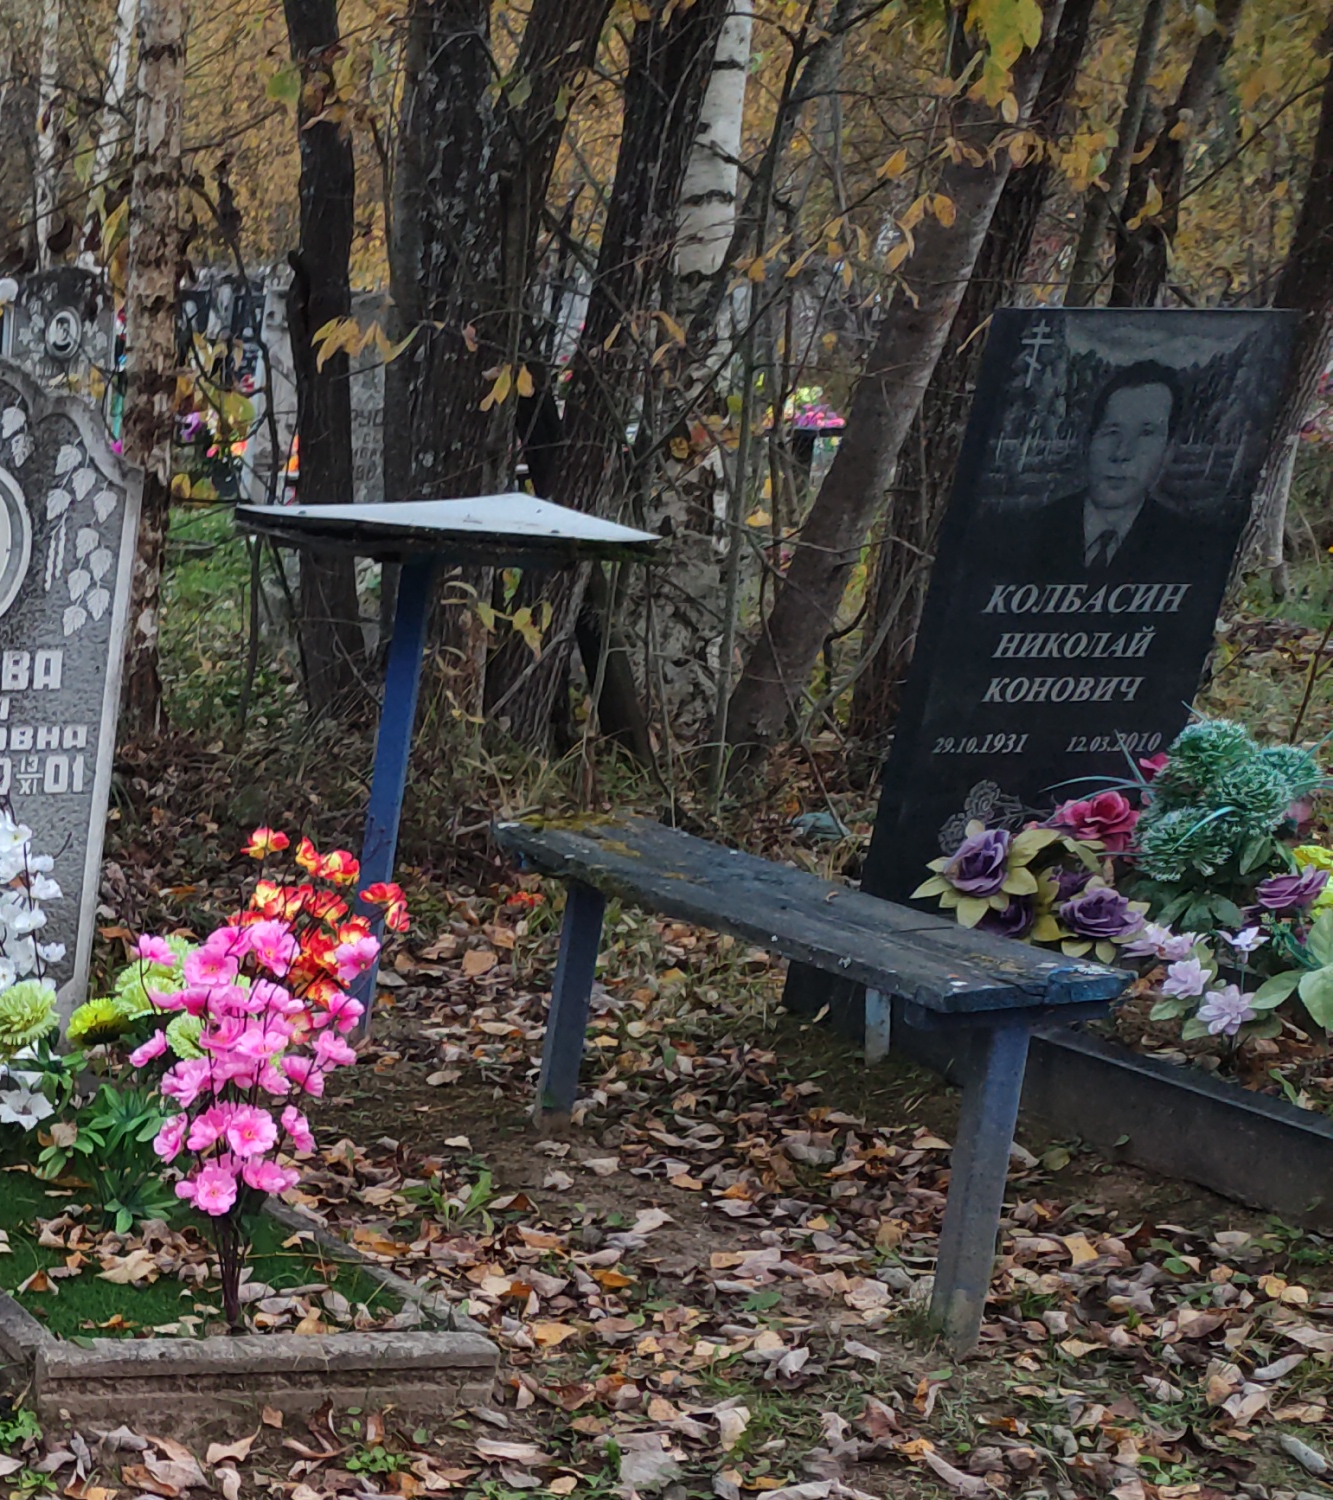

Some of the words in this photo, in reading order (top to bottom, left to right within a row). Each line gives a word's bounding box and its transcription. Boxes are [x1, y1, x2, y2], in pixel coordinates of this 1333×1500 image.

[982, 583, 1192, 614] КОЛБАСИН
[991, 625, 1156, 658] НИКОЛАЙ
[982, 676, 1146, 702] КОНОВИЧ
[932, 733, 1029, 754] 29.10.1931
